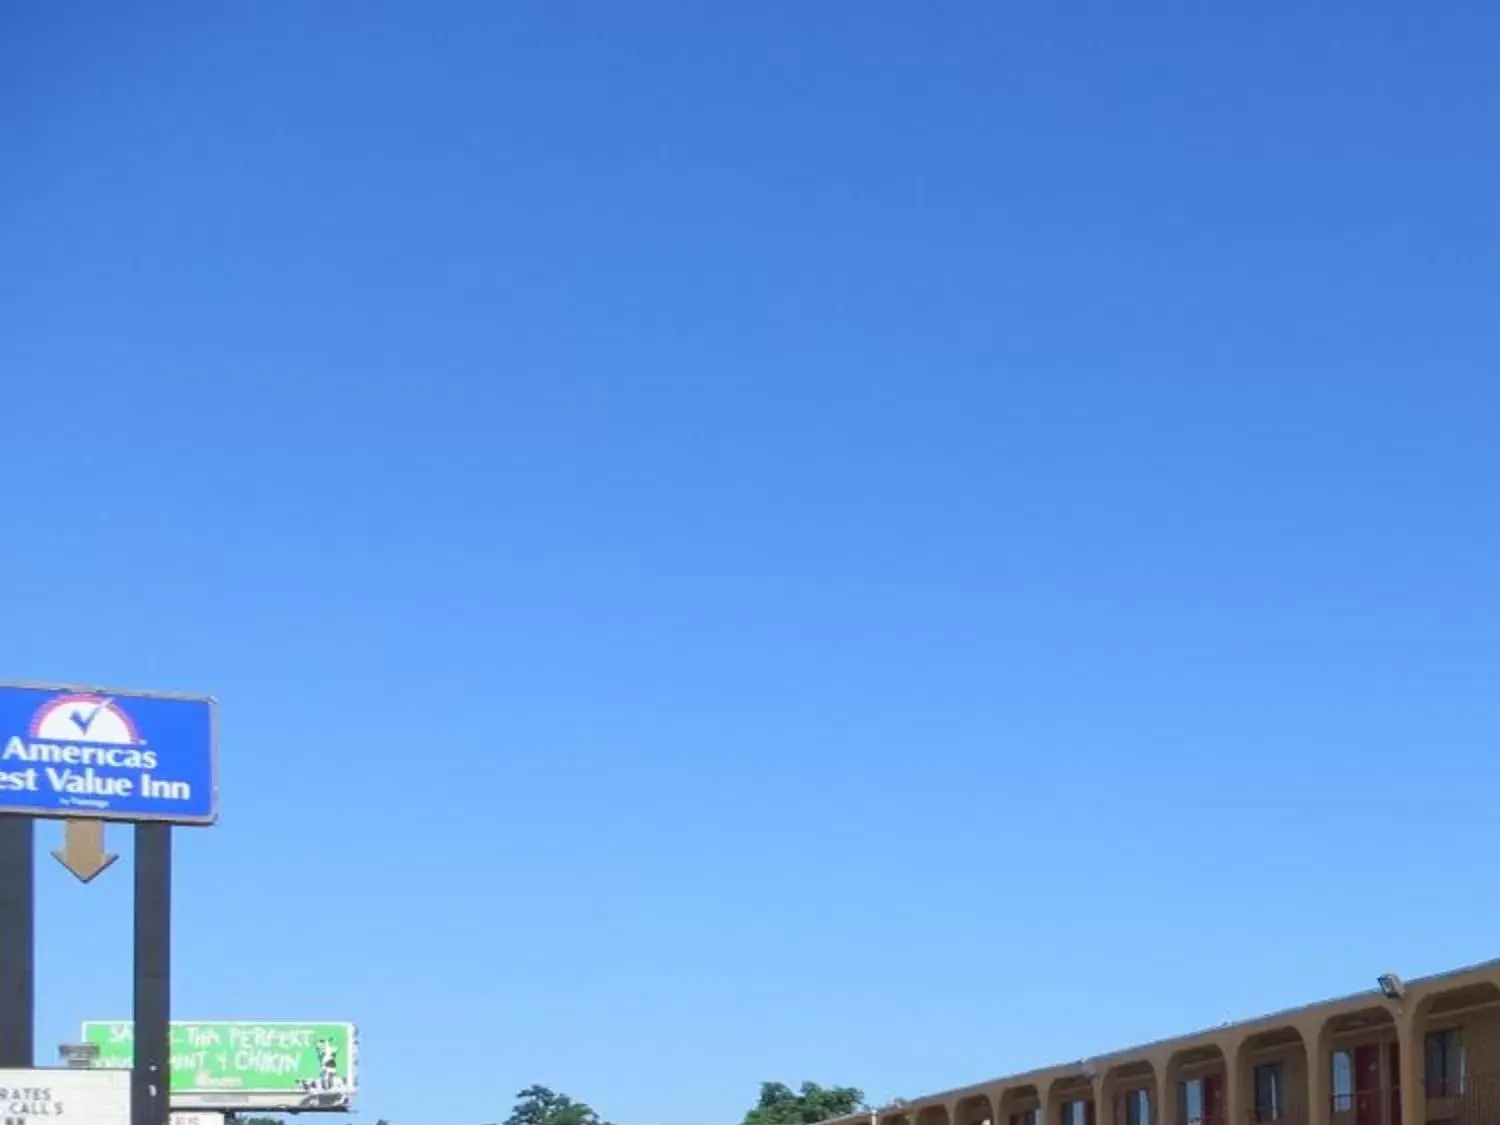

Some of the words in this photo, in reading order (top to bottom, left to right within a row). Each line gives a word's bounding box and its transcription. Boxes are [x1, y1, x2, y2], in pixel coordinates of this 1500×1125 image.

[3, 736, 157, 768] Americas
[45, 767, 133, 797] Value
[141, 773, 191, 801] Inn
